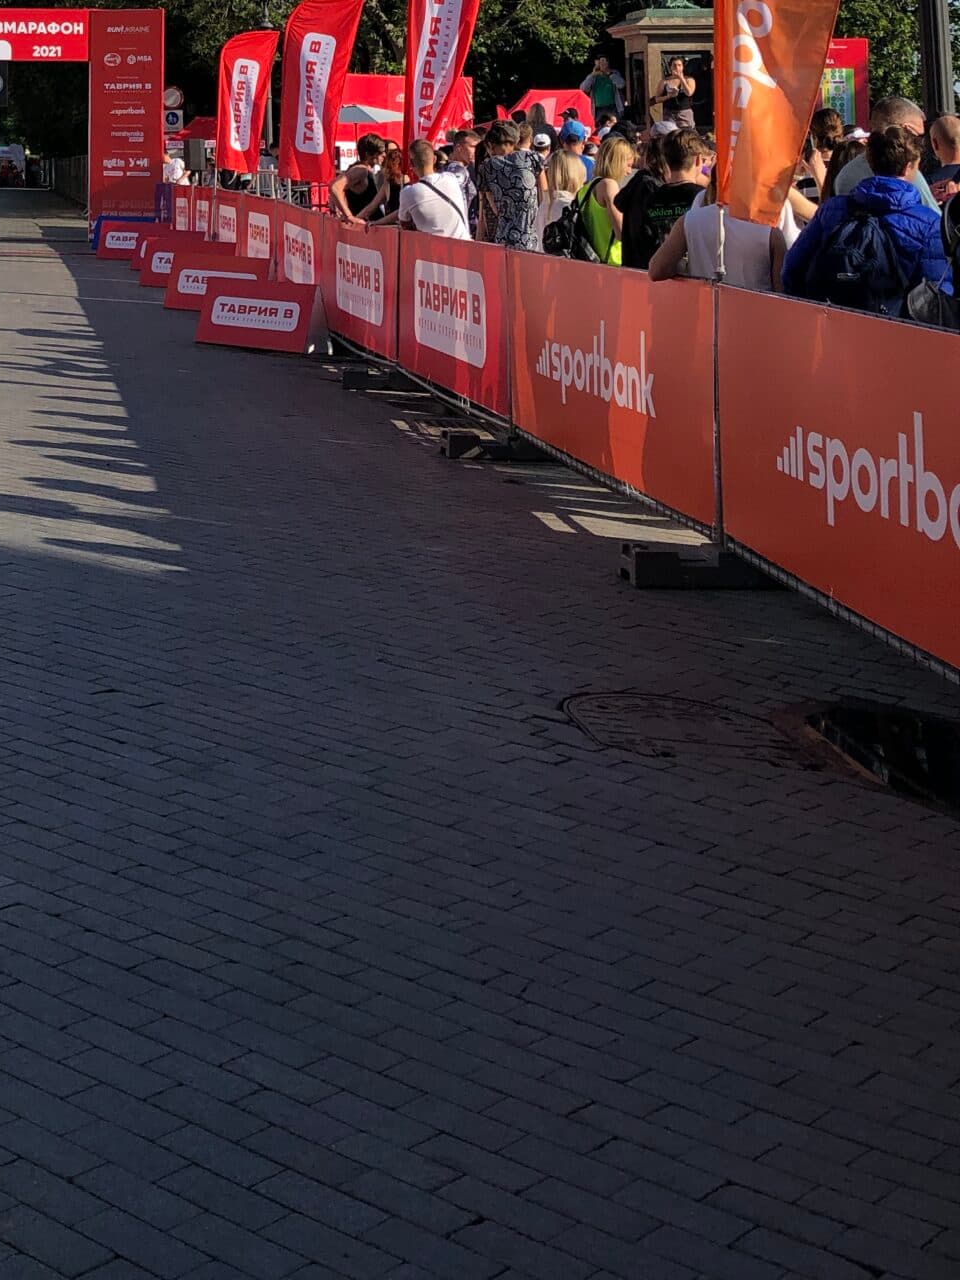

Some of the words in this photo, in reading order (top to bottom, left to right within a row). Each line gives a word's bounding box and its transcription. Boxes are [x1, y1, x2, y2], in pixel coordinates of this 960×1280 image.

[32, 46, 62, 57] 2021
[309, 40, 322, 54] В
[239, 64, 248, 75] В
[417, 16, 442, 134] ТАВРИЯ
[112, 106, 145, 116] sportbank
[233, 80, 246, 144] ТАВРИЯ
[302, 61, 317, 145] ТАВРИЯ
[285, 233, 307, 262] ТАВРИЯ
[338, 256, 371, 291] ТАВРИЯ
[373, 267, 381, 293] В
[219, 302, 279, 318] ТАВРИЯ
[283, 308, 294, 319] В
[418, 279, 468, 321] ТАВРИЯ
[472, 293, 481, 326] В
[551, 320, 656, 418] sportbank
